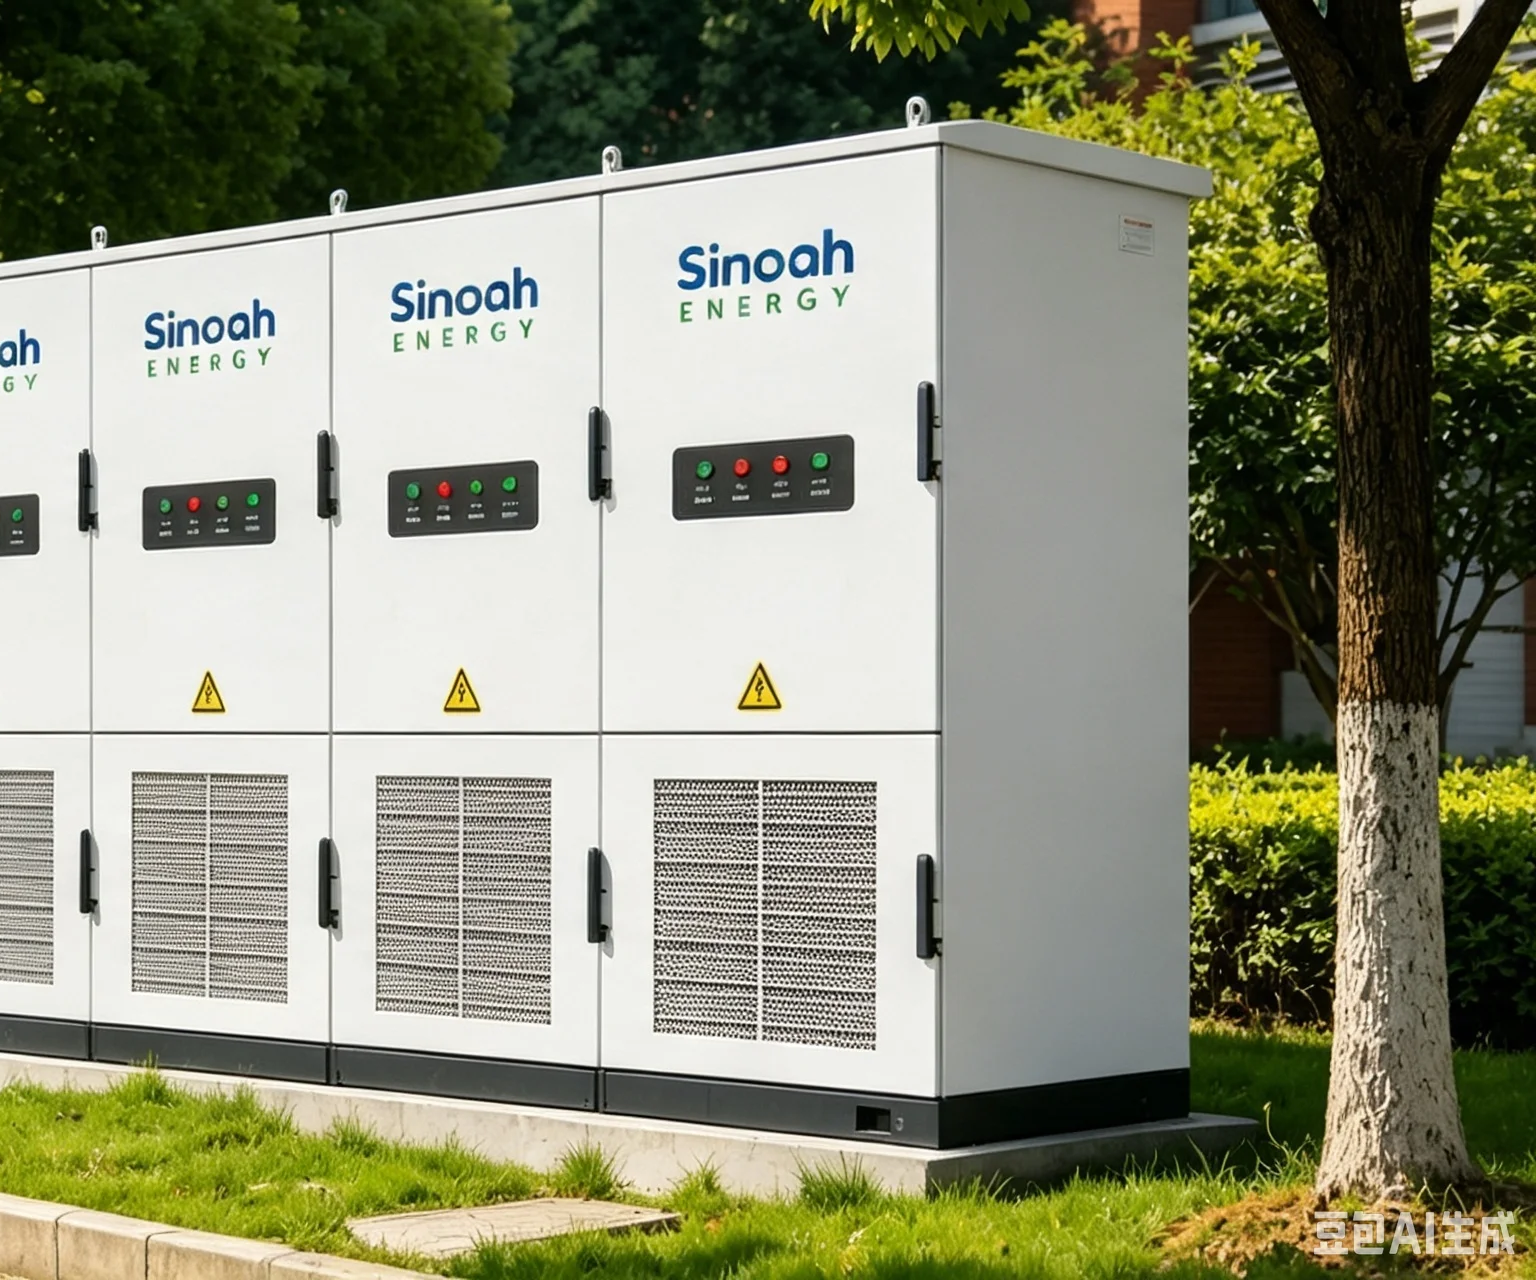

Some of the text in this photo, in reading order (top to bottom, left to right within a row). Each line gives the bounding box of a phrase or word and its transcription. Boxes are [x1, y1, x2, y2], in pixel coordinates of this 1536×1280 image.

[677, 227, 855, 291] Sinoah
[390, 266, 539, 323] Sinoah
[677, 286, 850, 324] ENERGY
[144, 299, 276, 350] Sinoah
[392, 319, 535, 353] ENERGY
[146, 348, 270, 379] ENERGY
